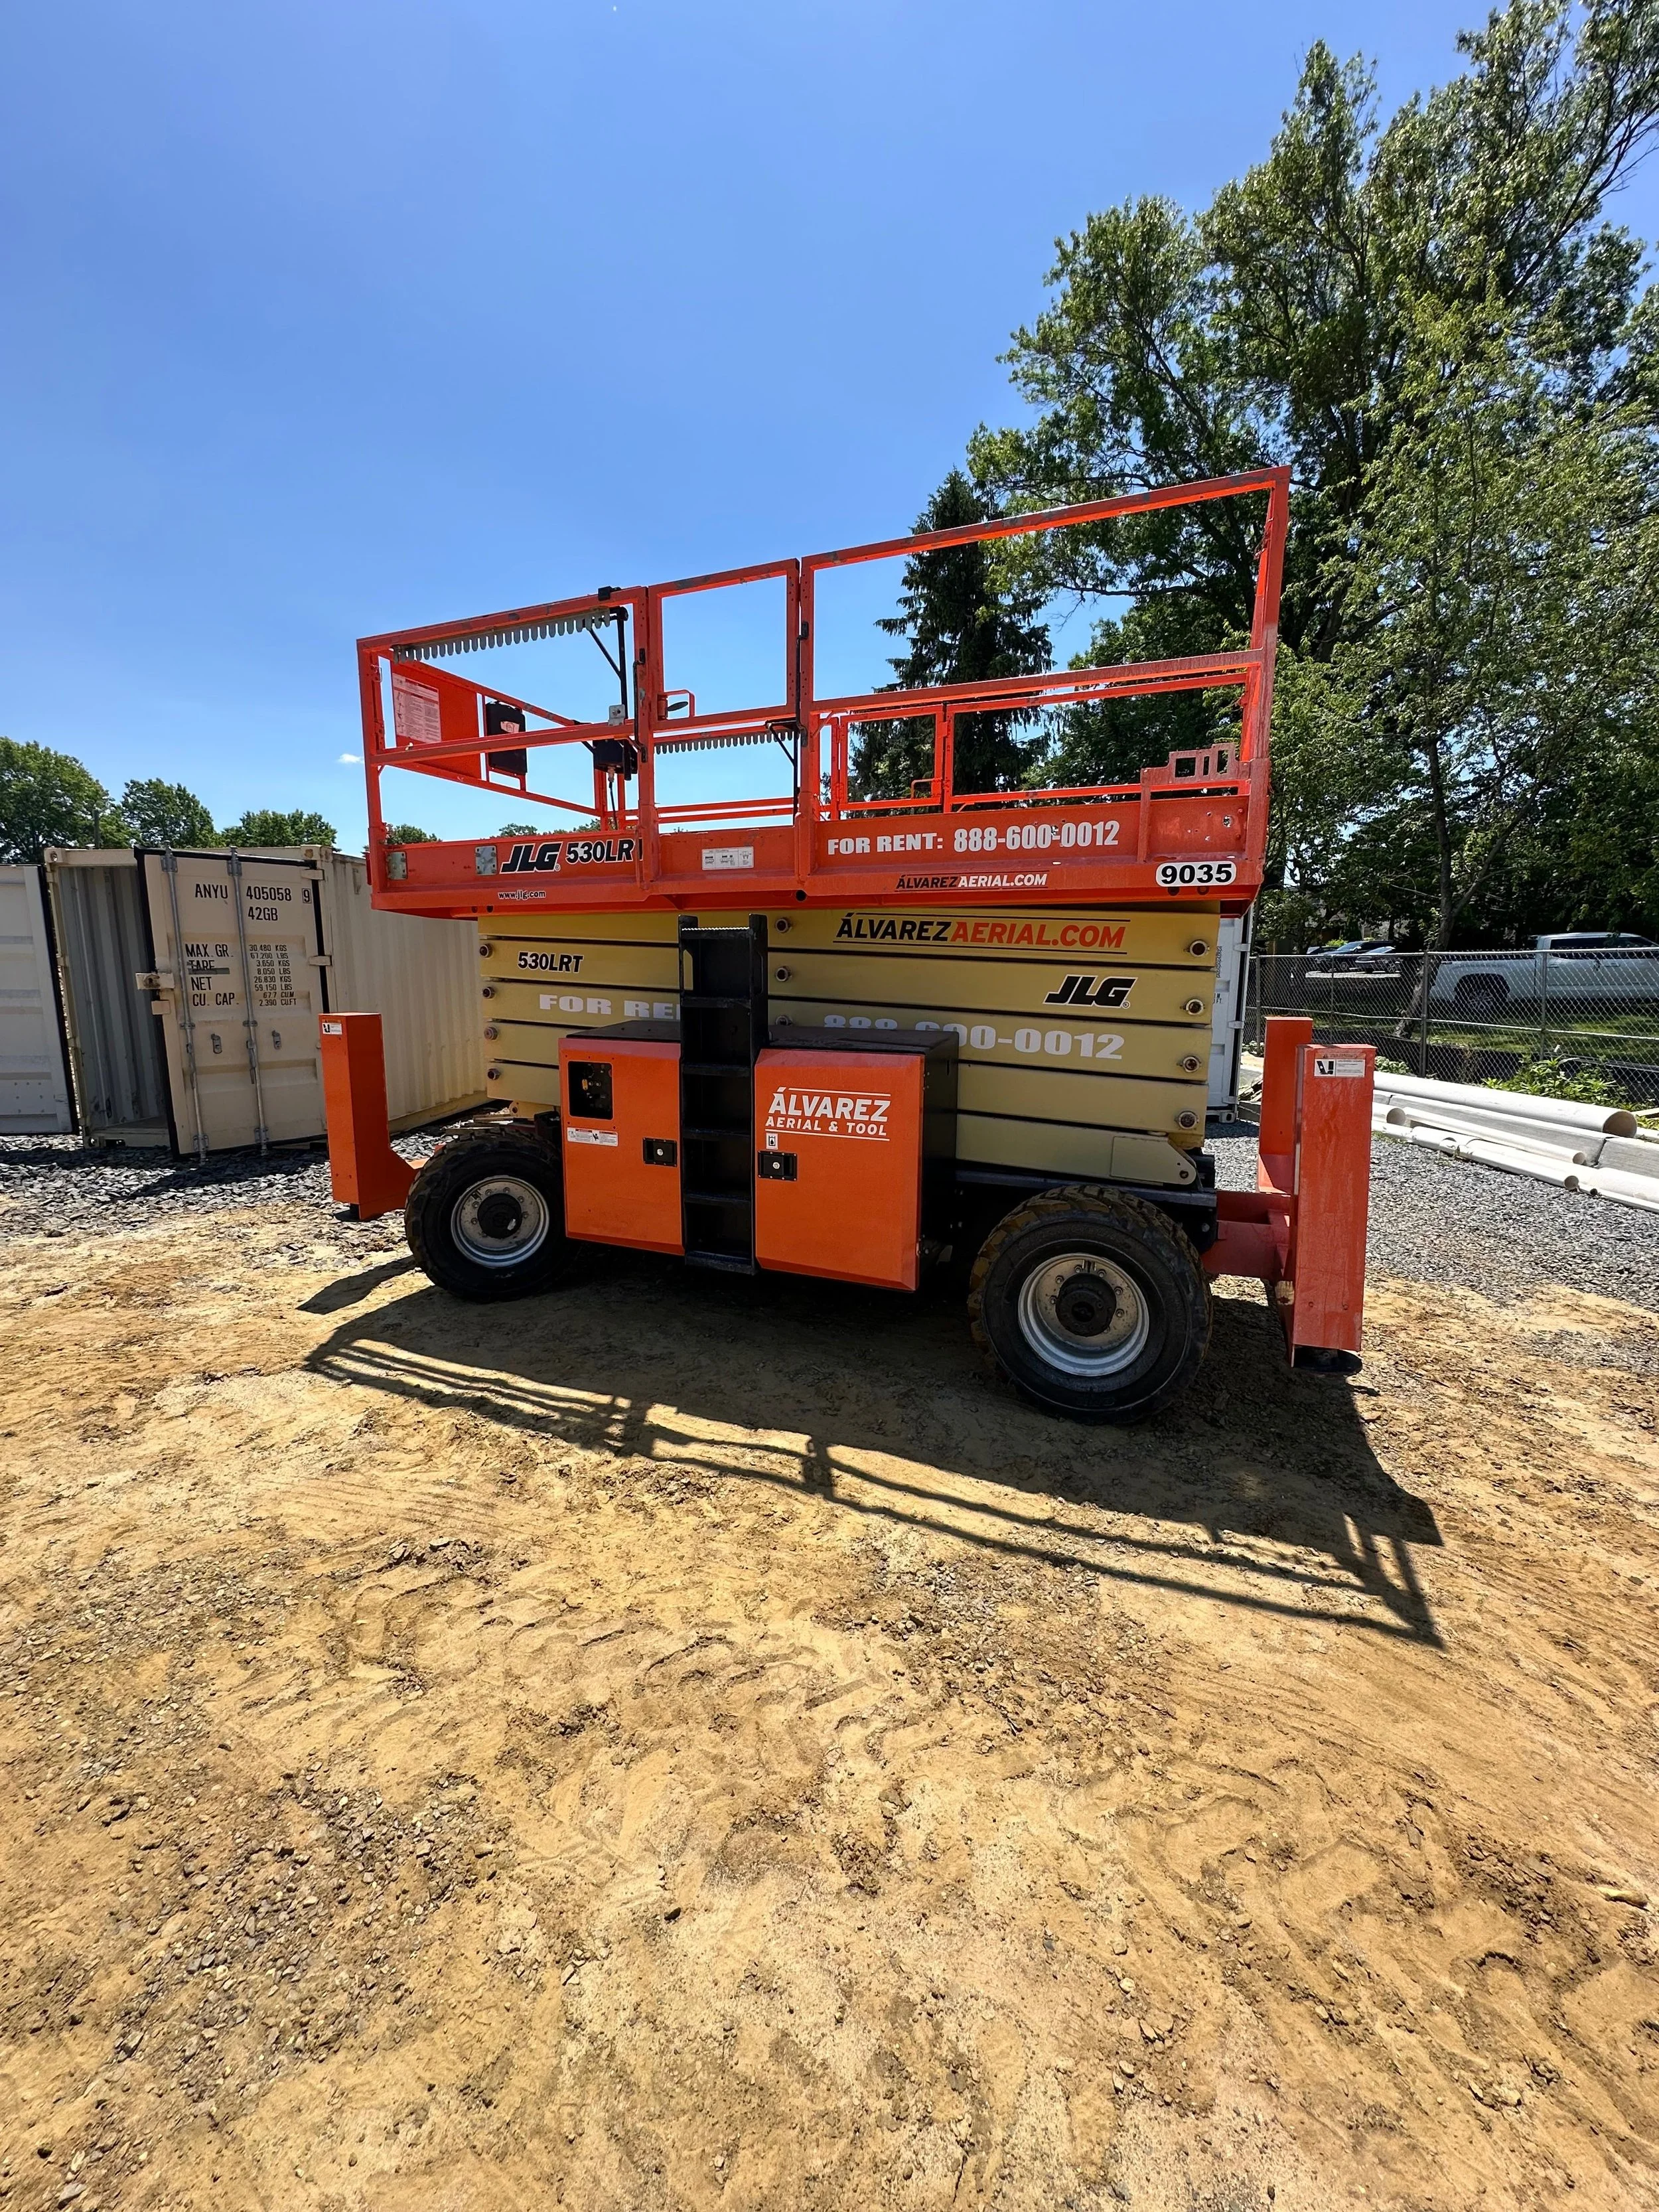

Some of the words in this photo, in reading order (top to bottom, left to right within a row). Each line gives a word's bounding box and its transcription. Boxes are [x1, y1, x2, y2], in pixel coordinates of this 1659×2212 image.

[828, 836, 871, 855] FOR
[877, 832, 944, 853] RENT:
[954, 820, 1120, 852] 888-600-0012
[499, 842, 563, 874] JLG
[897, 873, 1048, 889] ÁLVAREZAERIAL.COM
[1161, 863, 1232, 885] 9035
[195, 883, 228, 899] ANYU
[246, 885, 291, 902] 405058
[303, 889, 311, 903] 9
[498, 890, 545, 901] www.jlg.com
[248, 906, 279, 921] 42GB
[836, 913, 1126, 949] ÁLVAREZAERIAL.COM
[518, 951, 584, 974] 530LRT
[190, 976, 212, 991] NET
[1043, 974, 1138, 1007] JLG
[192, 993, 210, 1007] CU.
[215, 992, 239, 1005] CAP.
[540, 994, 612, 1015] FOR
[624, 1000, 680, 1020] RE
[768, 1086, 891, 1122] ÁLVAREZ
[765, 1116, 822, 1131] AERIAL
[829, 1121, 839, 1133] &
[846, 1122, 887, 1136] TOOL
